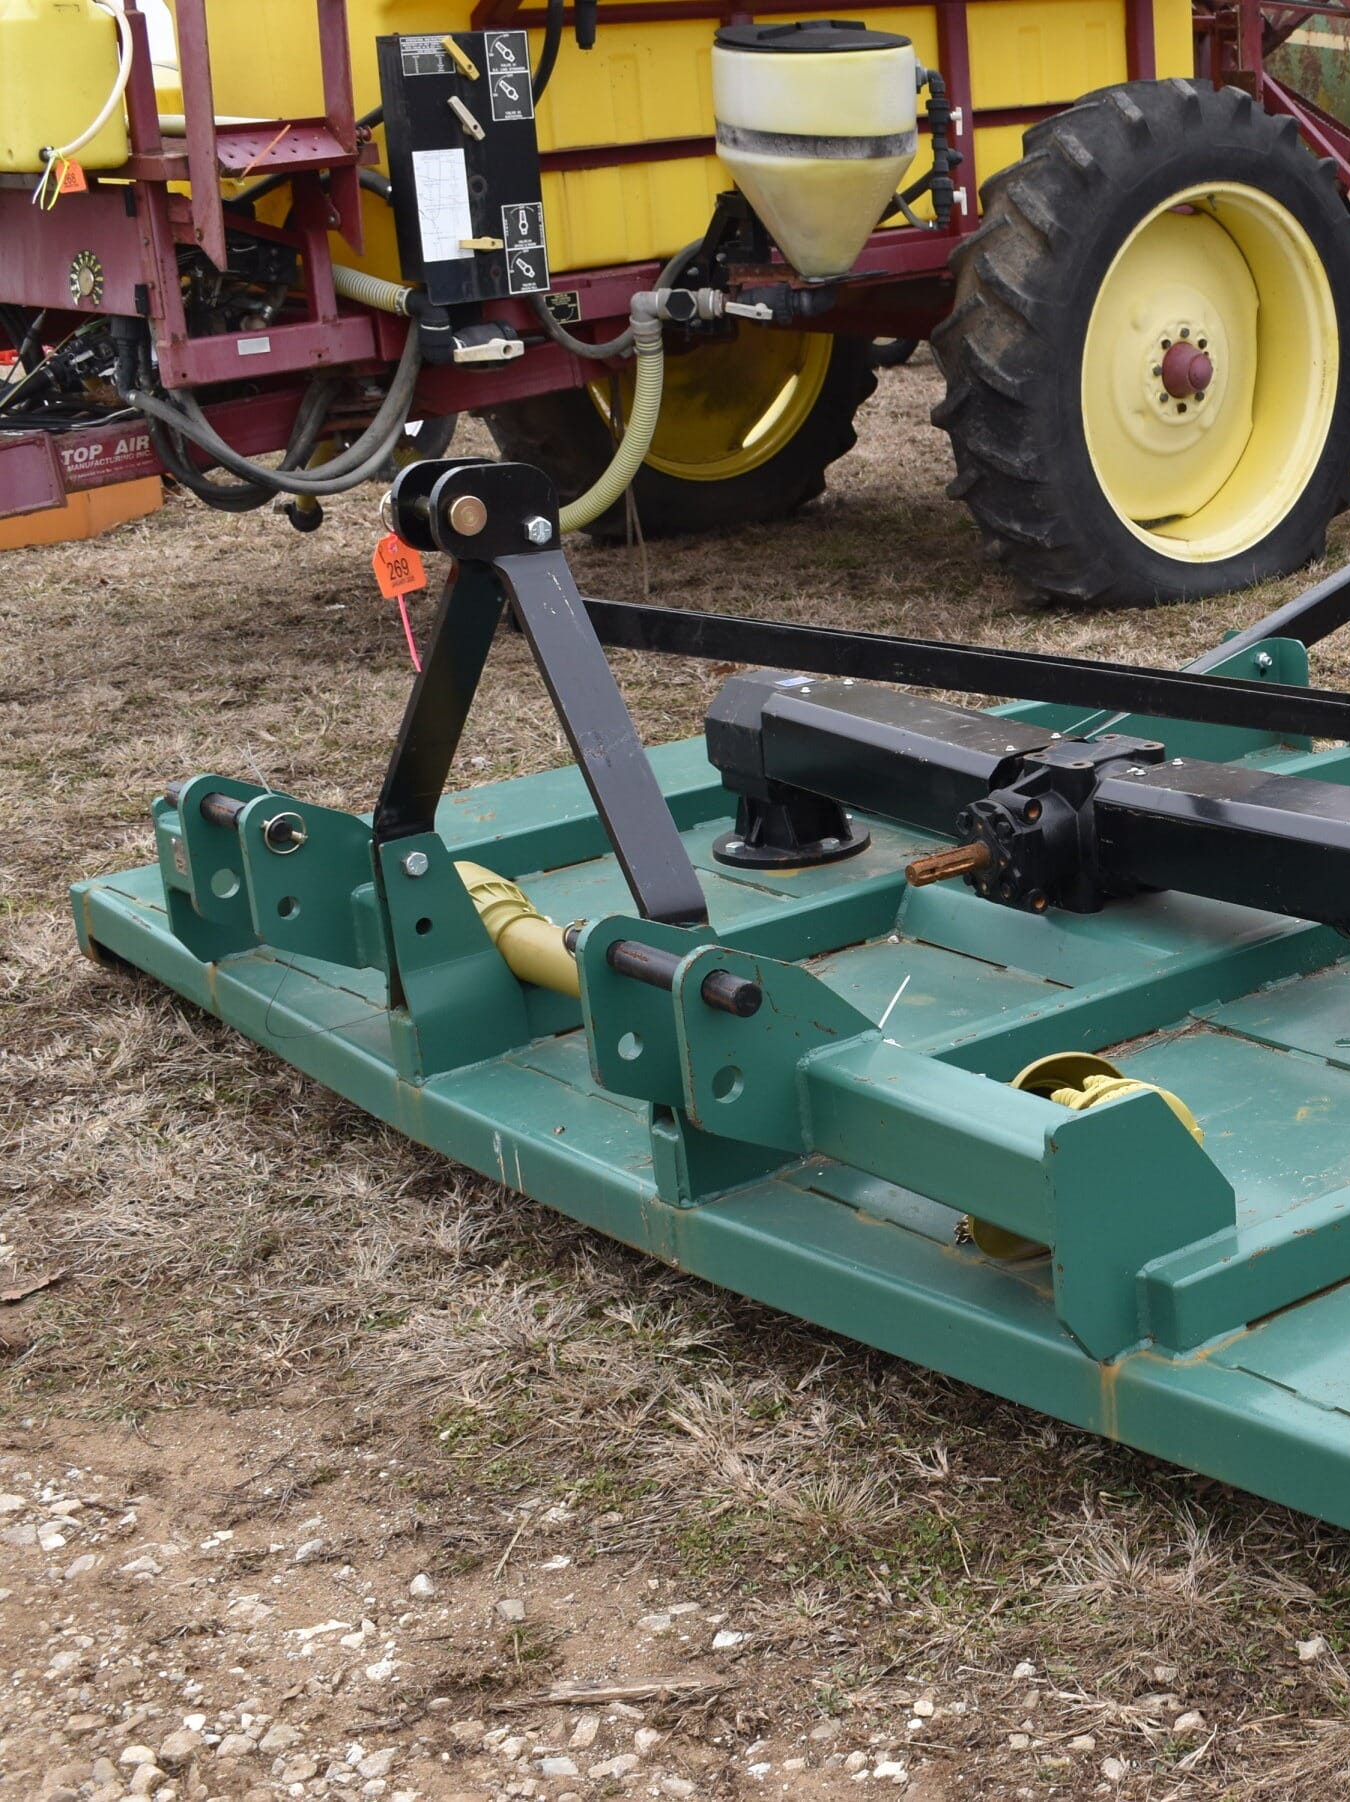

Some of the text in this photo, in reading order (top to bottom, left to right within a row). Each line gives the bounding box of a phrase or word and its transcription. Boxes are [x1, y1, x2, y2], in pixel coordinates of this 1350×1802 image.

[61, 435, 150, 466] TOP AIR
[67, 453, 134, 472] MANUFACTURING
[387, 558, 409, 581] 269
